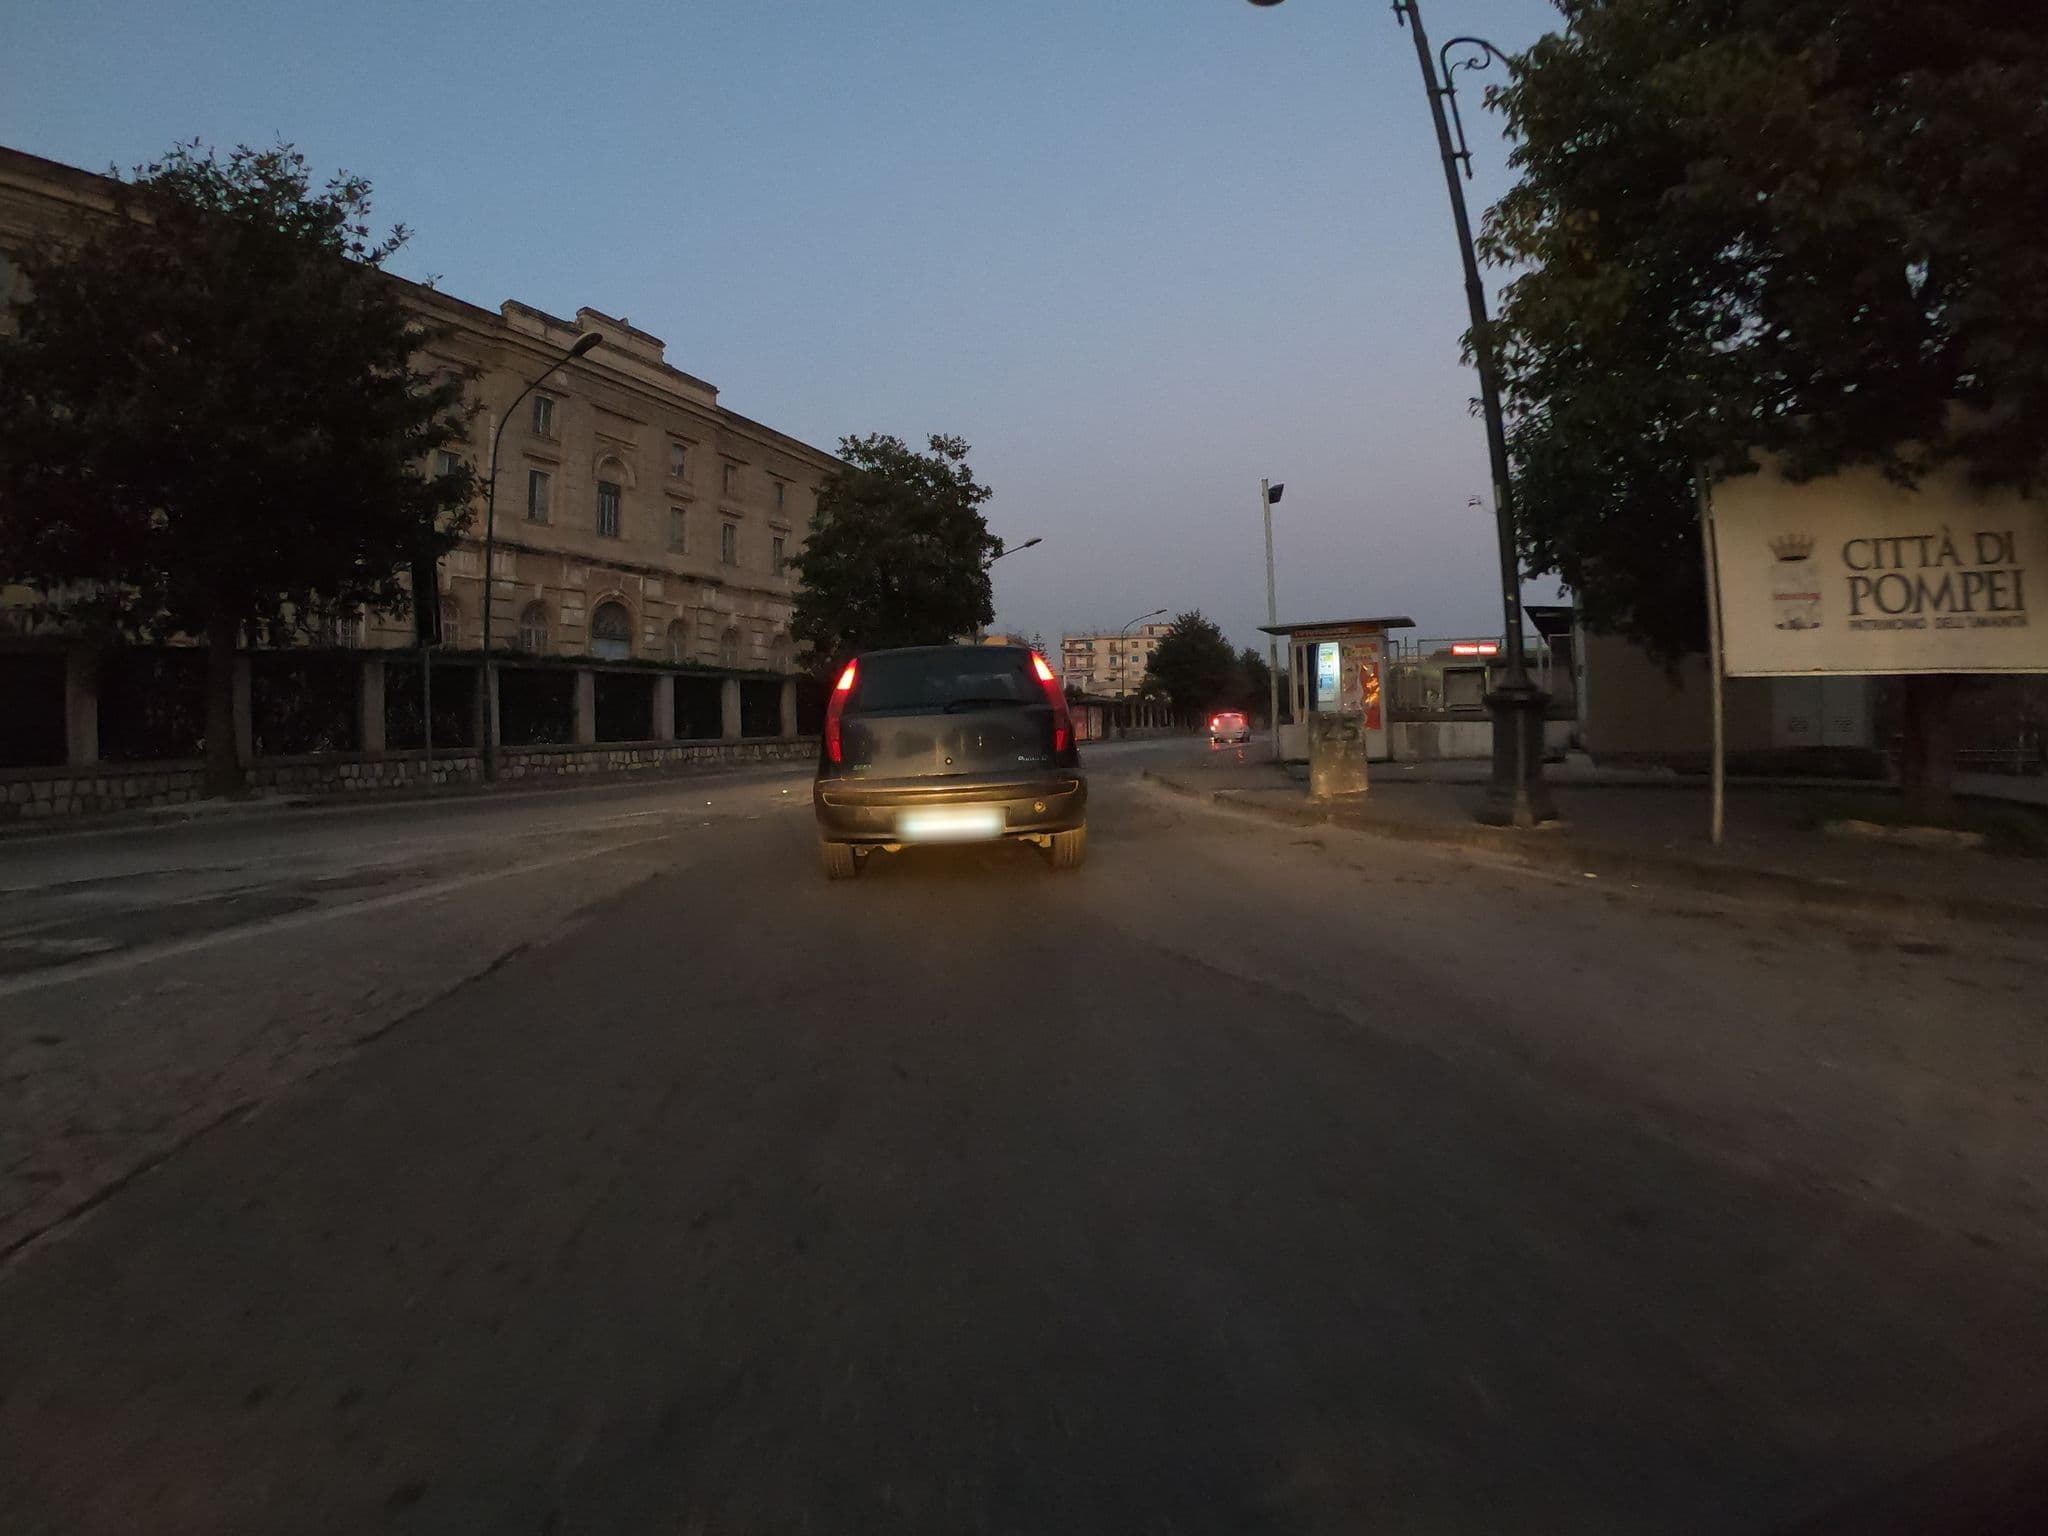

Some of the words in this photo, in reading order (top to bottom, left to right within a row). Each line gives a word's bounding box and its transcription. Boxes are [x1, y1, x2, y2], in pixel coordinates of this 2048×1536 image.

[1842, 523, 1964, 571] CITTÀ
[1972, 530, 2018, 565] DI
[1845, 568, 2026, 615] POMPEI
